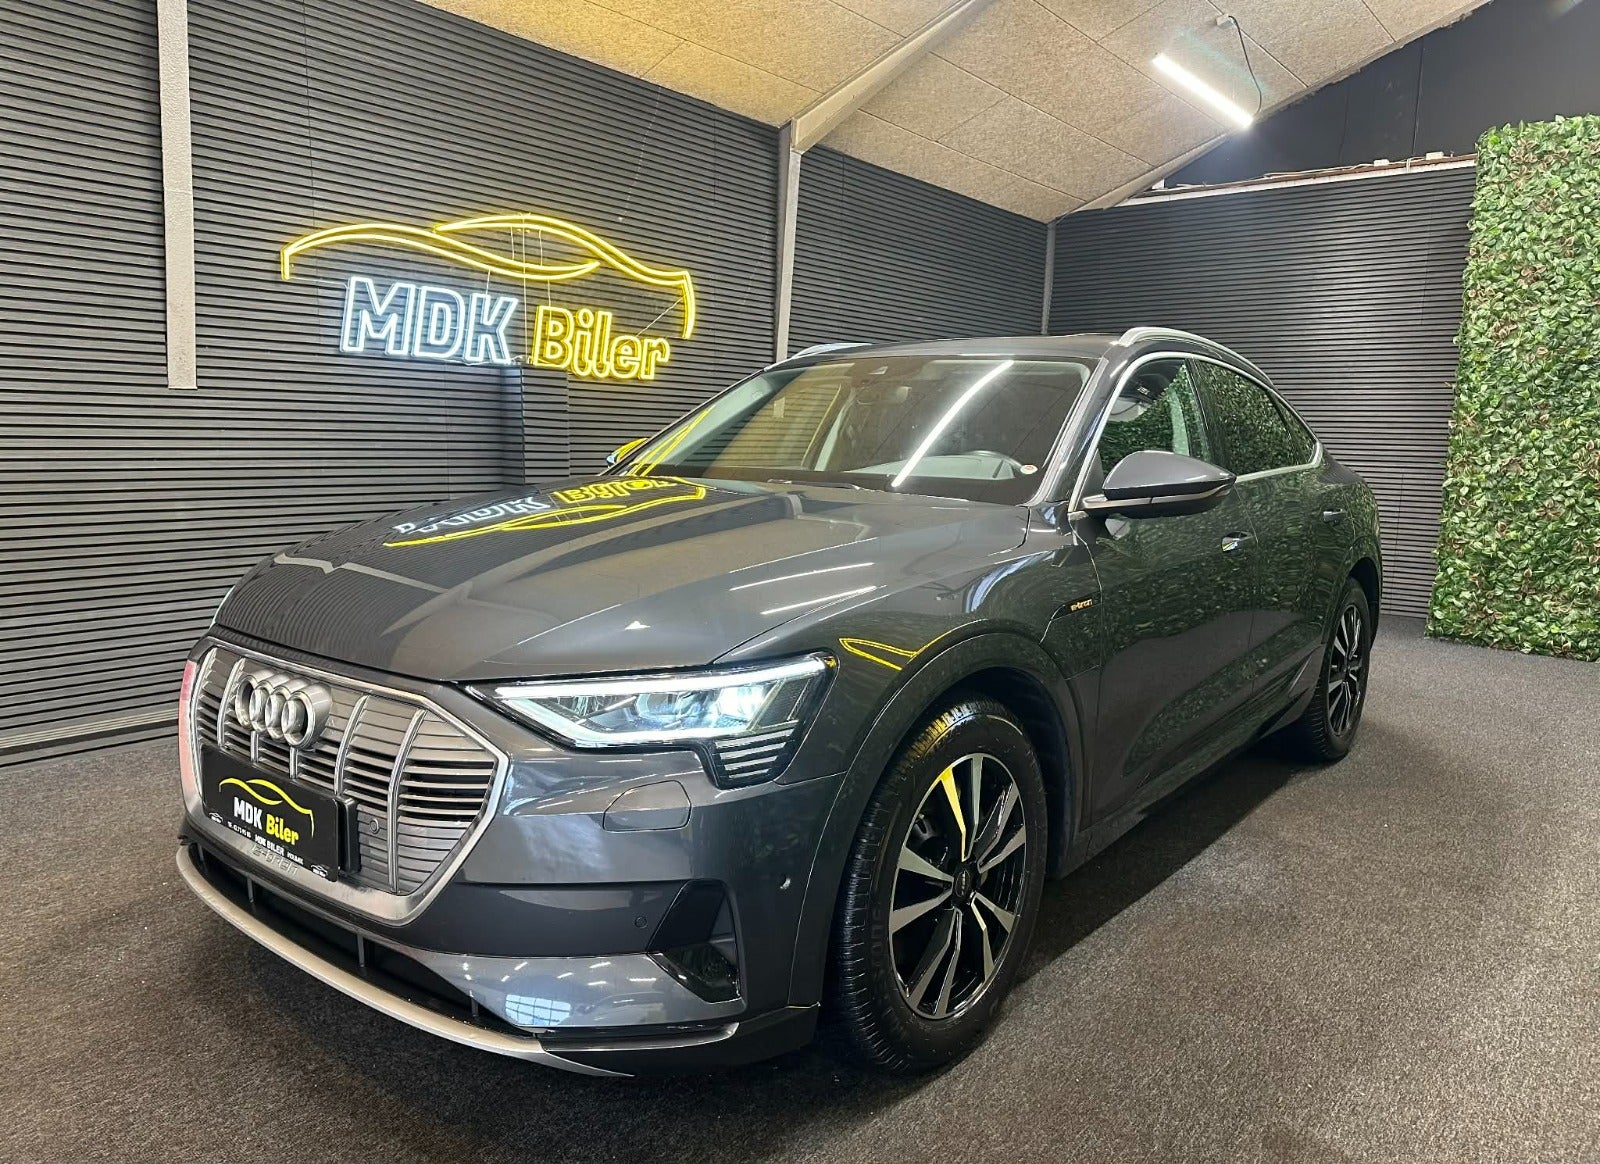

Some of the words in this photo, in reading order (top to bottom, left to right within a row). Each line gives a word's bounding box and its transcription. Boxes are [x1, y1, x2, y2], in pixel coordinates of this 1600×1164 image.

[340, 276, 518, 366] MDK
[532, 305, 670, 380] Biler
[234, 797, 262, 830] MDK
[267, 814, 299, 845] Biler
[266, 840, 285, 856] BILER
